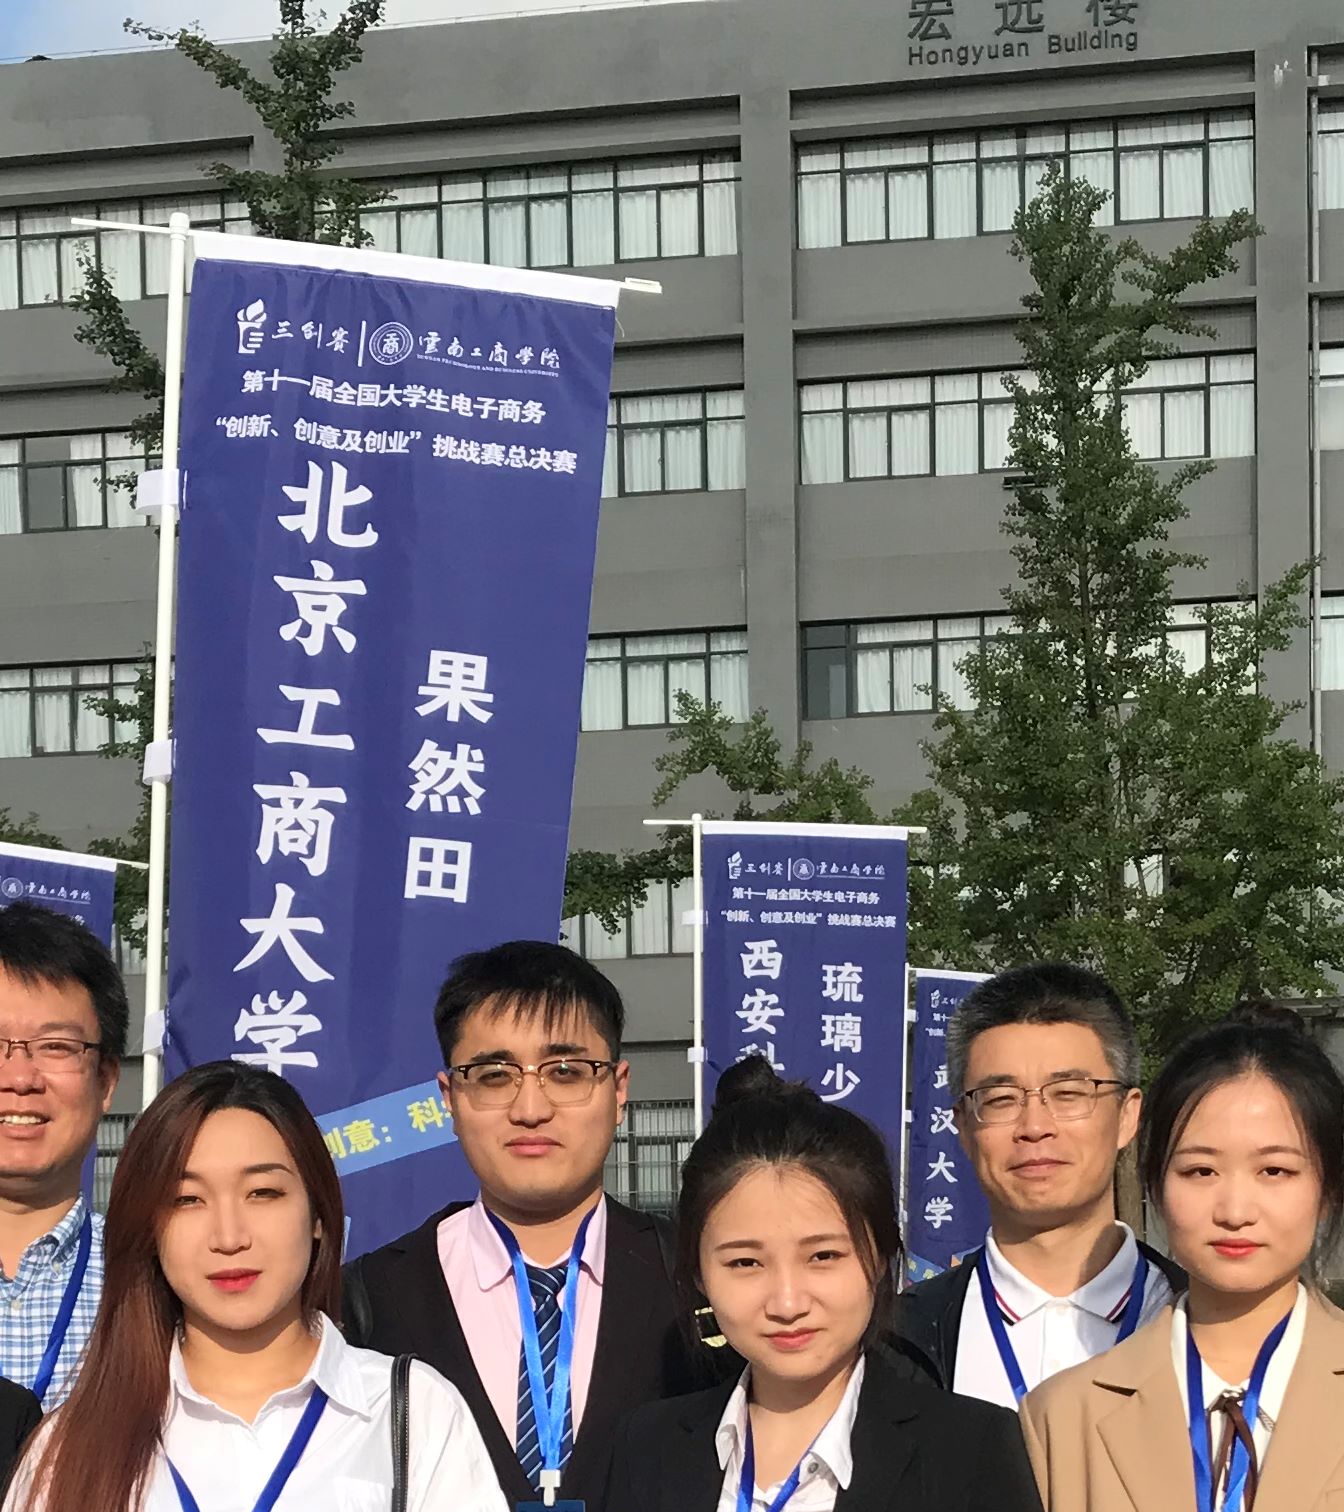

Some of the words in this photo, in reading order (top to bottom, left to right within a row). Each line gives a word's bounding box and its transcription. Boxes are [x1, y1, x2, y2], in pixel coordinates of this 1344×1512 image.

[908, 42, 1029, 66] Hongyuan
[1048, 31, 1138, 54] Building
[241, 369, 546, 424] 第十一届全国大学生电子商务
[230, 460, 379, 1077] 北京工商大学
[403, 649, 495, 904] 果然田
